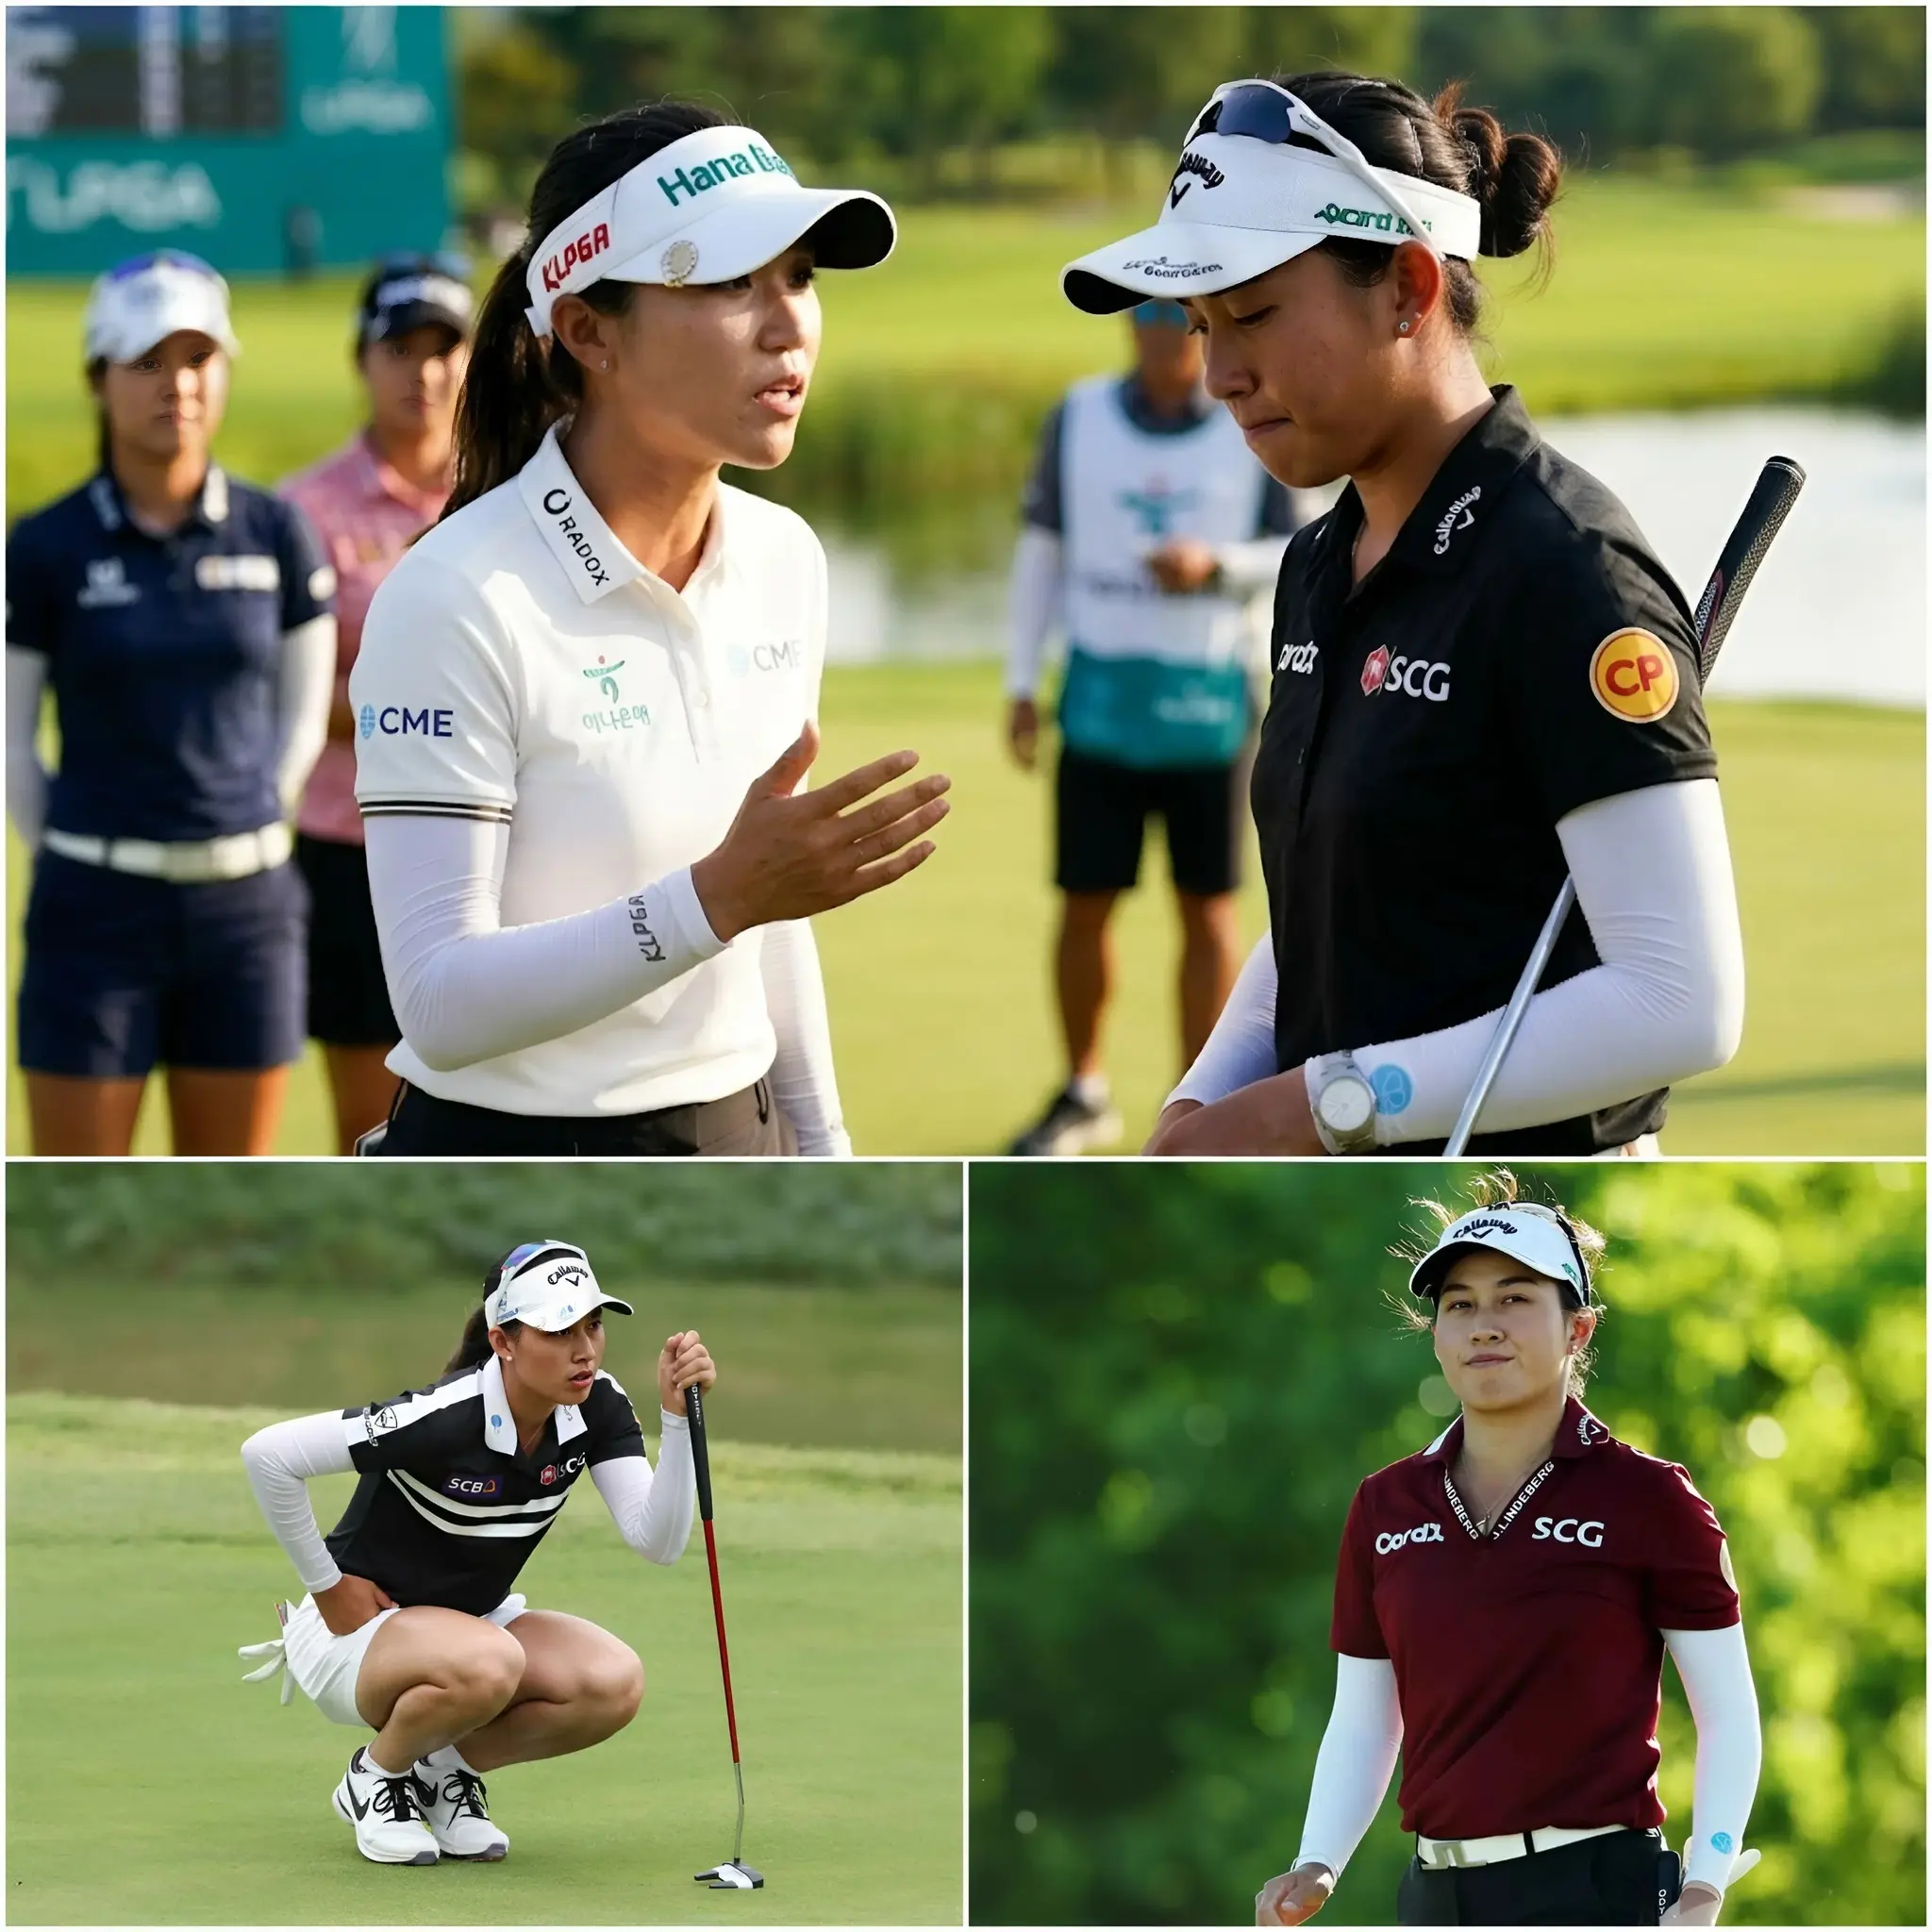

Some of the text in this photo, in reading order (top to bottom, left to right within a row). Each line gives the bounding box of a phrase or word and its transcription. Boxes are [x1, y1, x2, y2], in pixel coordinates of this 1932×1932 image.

[658, 153, 755, 207] Hana
[541, 223, 610, 292] KLPGA
[1384, 656, 1451, 702] SCG
[1606, 654, 1664, 696] CP
[379, 707, 453, 737] CME
[628, 894, 666, 961] KLPGA
[1453, 1218, 1519, 1240] Callaway
[448, 1477, 484, 1493] SCB
[1492, 1461, 1555, 1541] J.LINDEBERG
[1531, 1517, 1605, 1548] SCG
